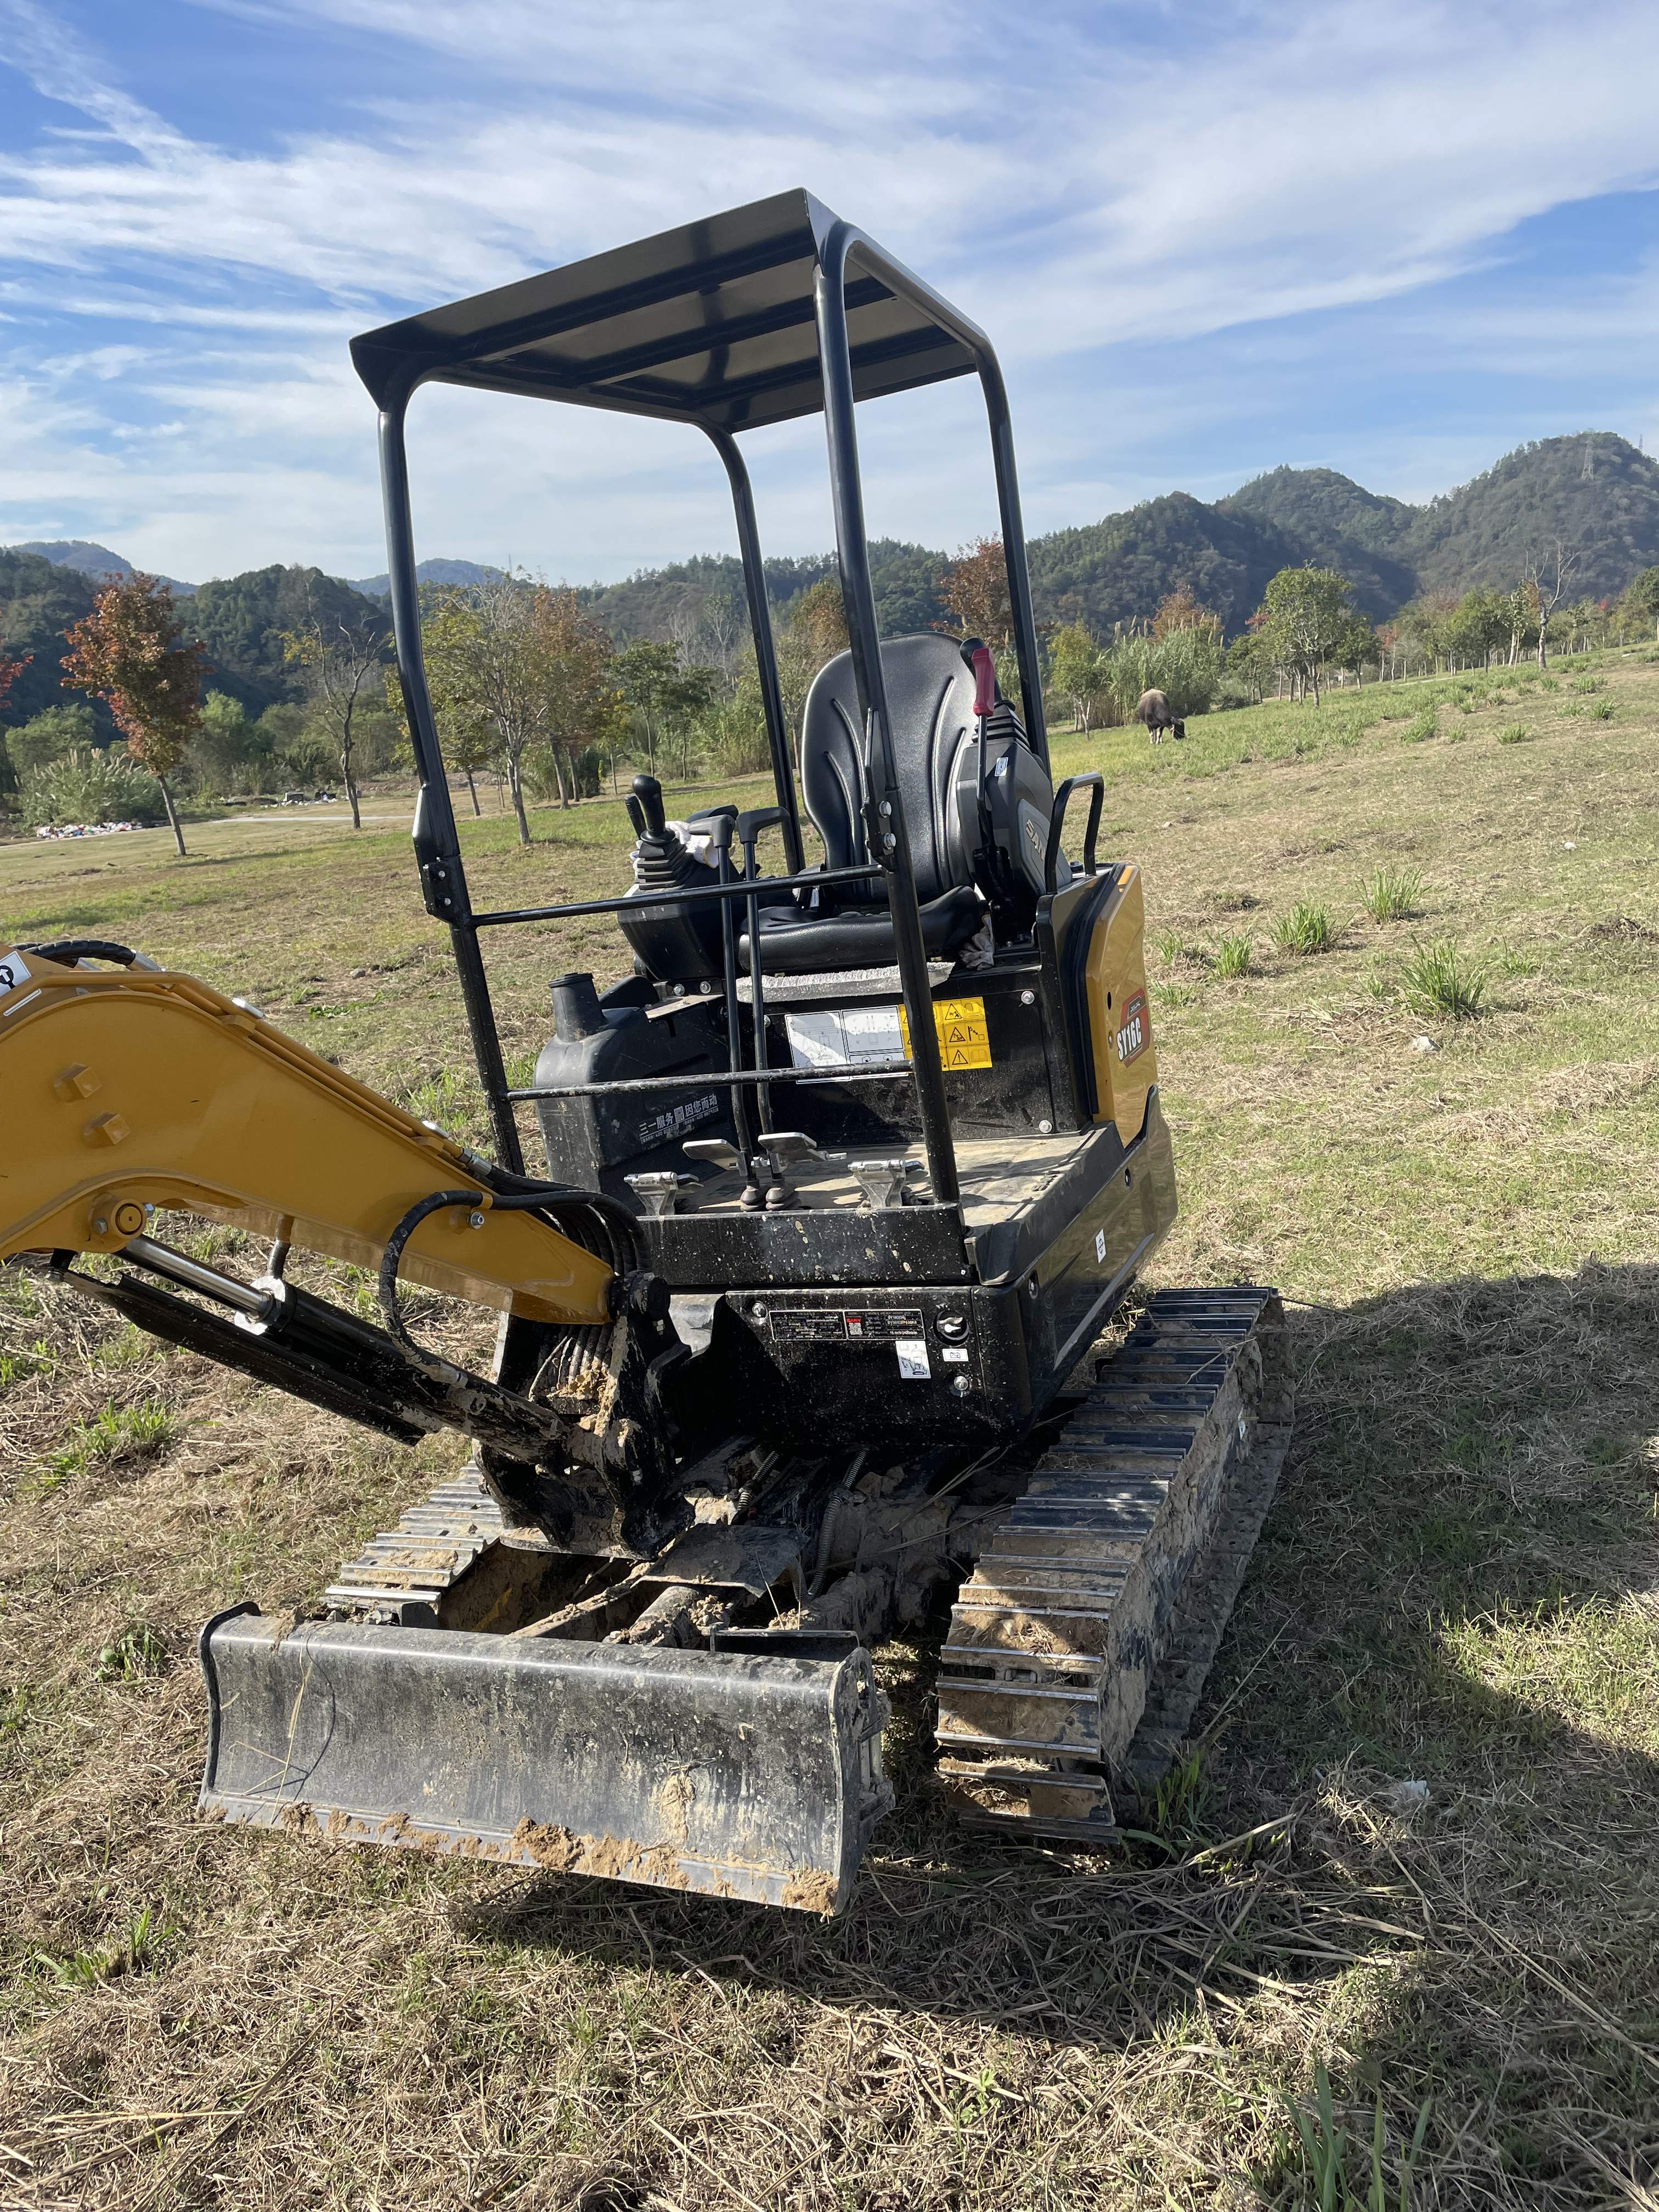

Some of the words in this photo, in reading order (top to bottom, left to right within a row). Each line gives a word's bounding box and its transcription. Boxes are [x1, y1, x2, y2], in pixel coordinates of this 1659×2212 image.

[1025, 819, 1046, 861] SAN
[1117, 1017, 1142, 1060] SY16C
[639, 1111, 674, 1136] 三一服务
[685, 1093, 718, 1118] 因您而动
